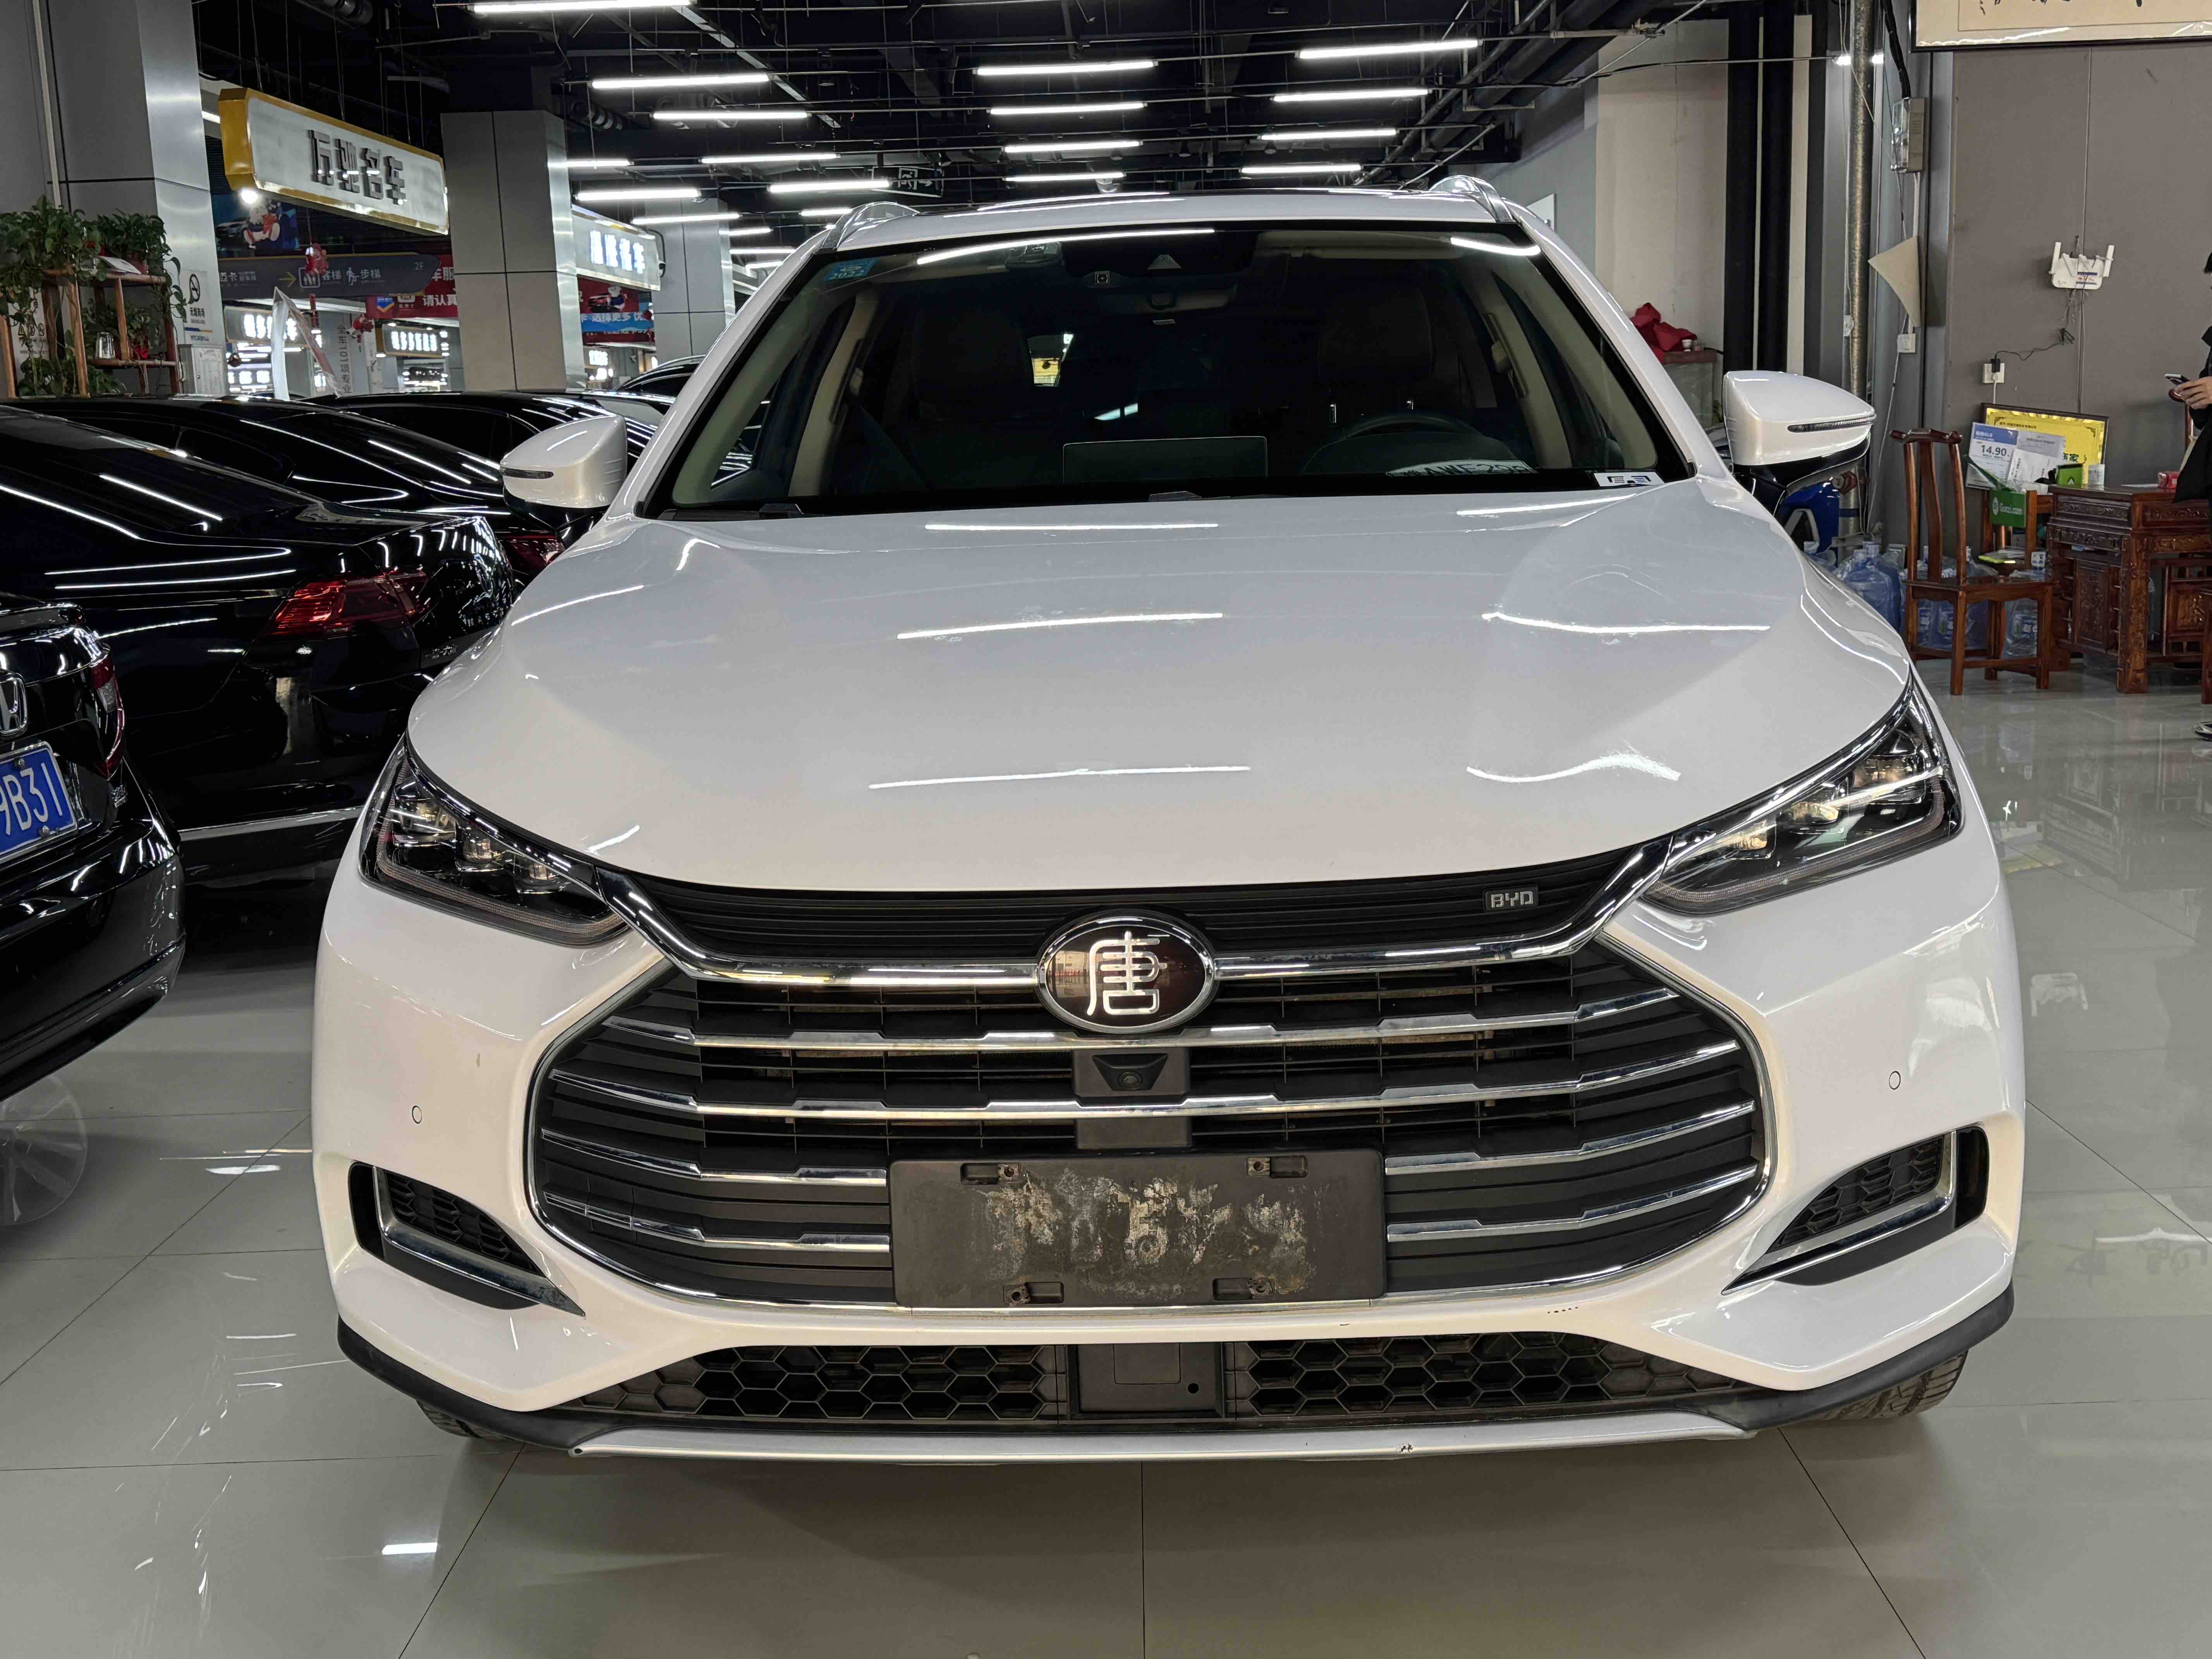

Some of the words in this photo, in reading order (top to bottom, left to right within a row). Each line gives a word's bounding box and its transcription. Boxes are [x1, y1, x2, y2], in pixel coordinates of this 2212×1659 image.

[414, 262, 424, 270] 2F
[360, 269, 381, 279] 步梯
[1981, 445, 2007, 457] 14.90
[1491, 891, 1534, 908] BYD
[1087, 931, 1167, 1016] 唐
